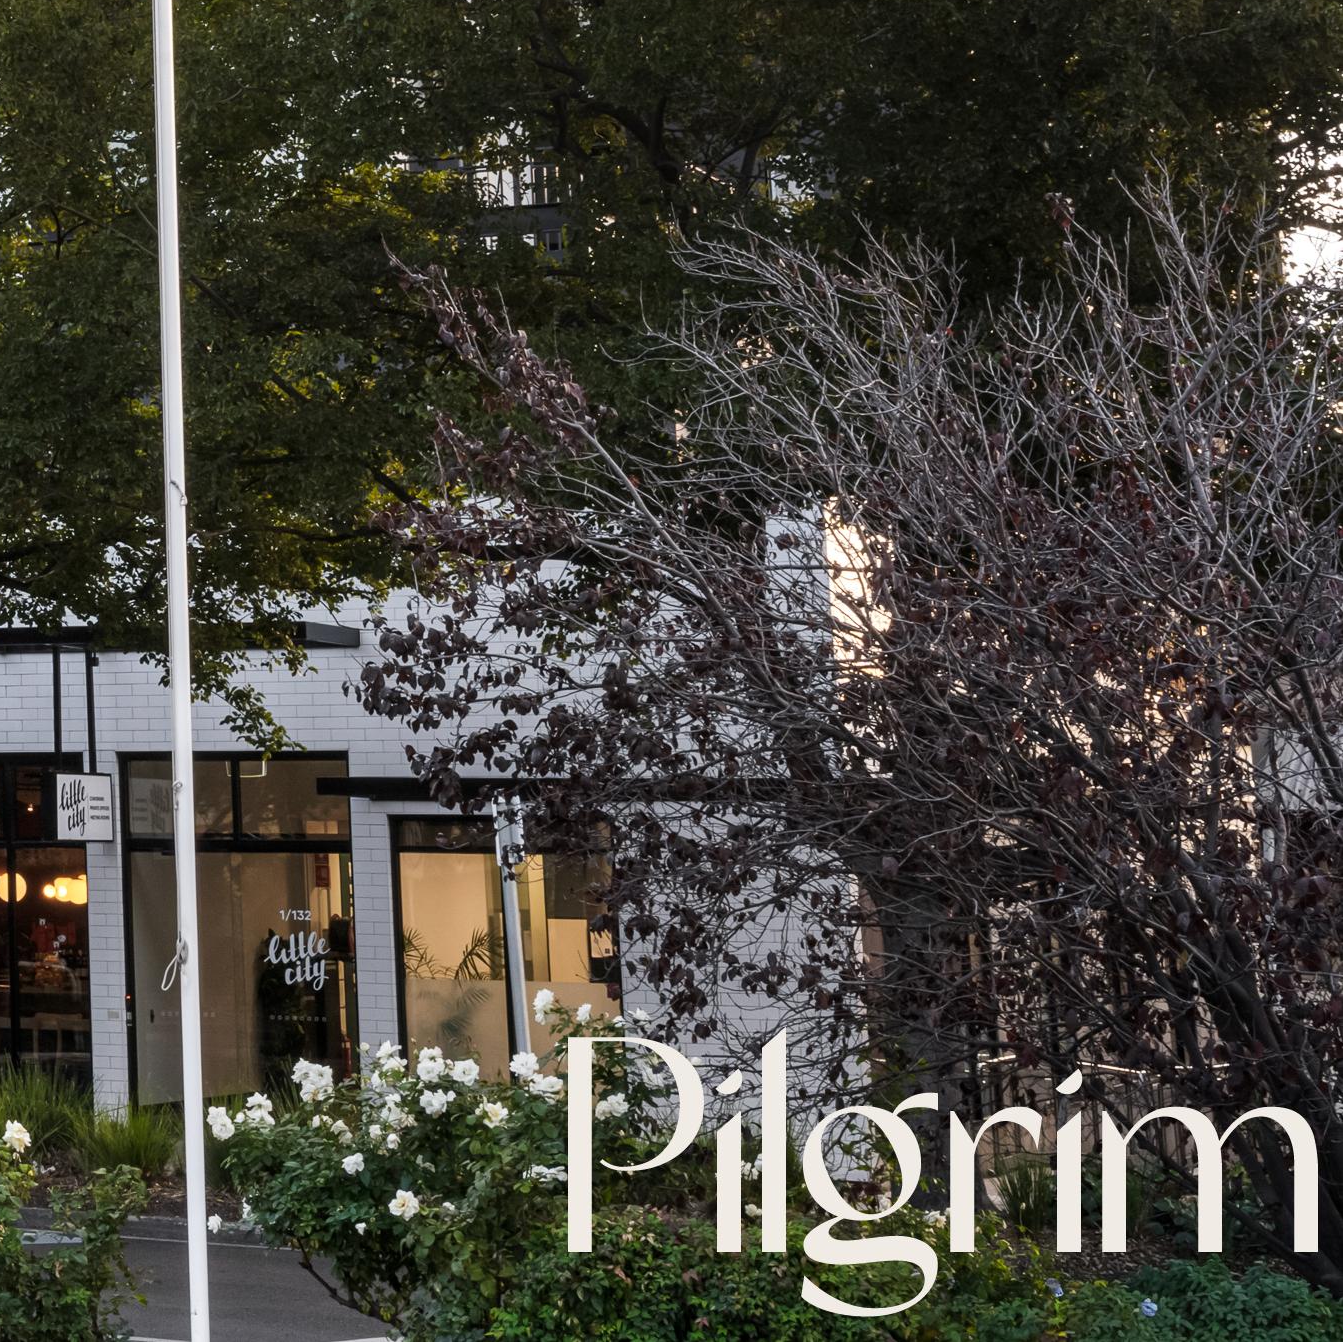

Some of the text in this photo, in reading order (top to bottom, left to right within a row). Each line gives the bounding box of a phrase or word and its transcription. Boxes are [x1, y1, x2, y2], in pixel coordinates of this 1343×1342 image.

[59, 779, 86, 810] little
[68, 804, 86, 836] city
[279, 909, 312, 922] 1/132
[263, 931, 331, 964] little
[284, 955, 329, 991] city
